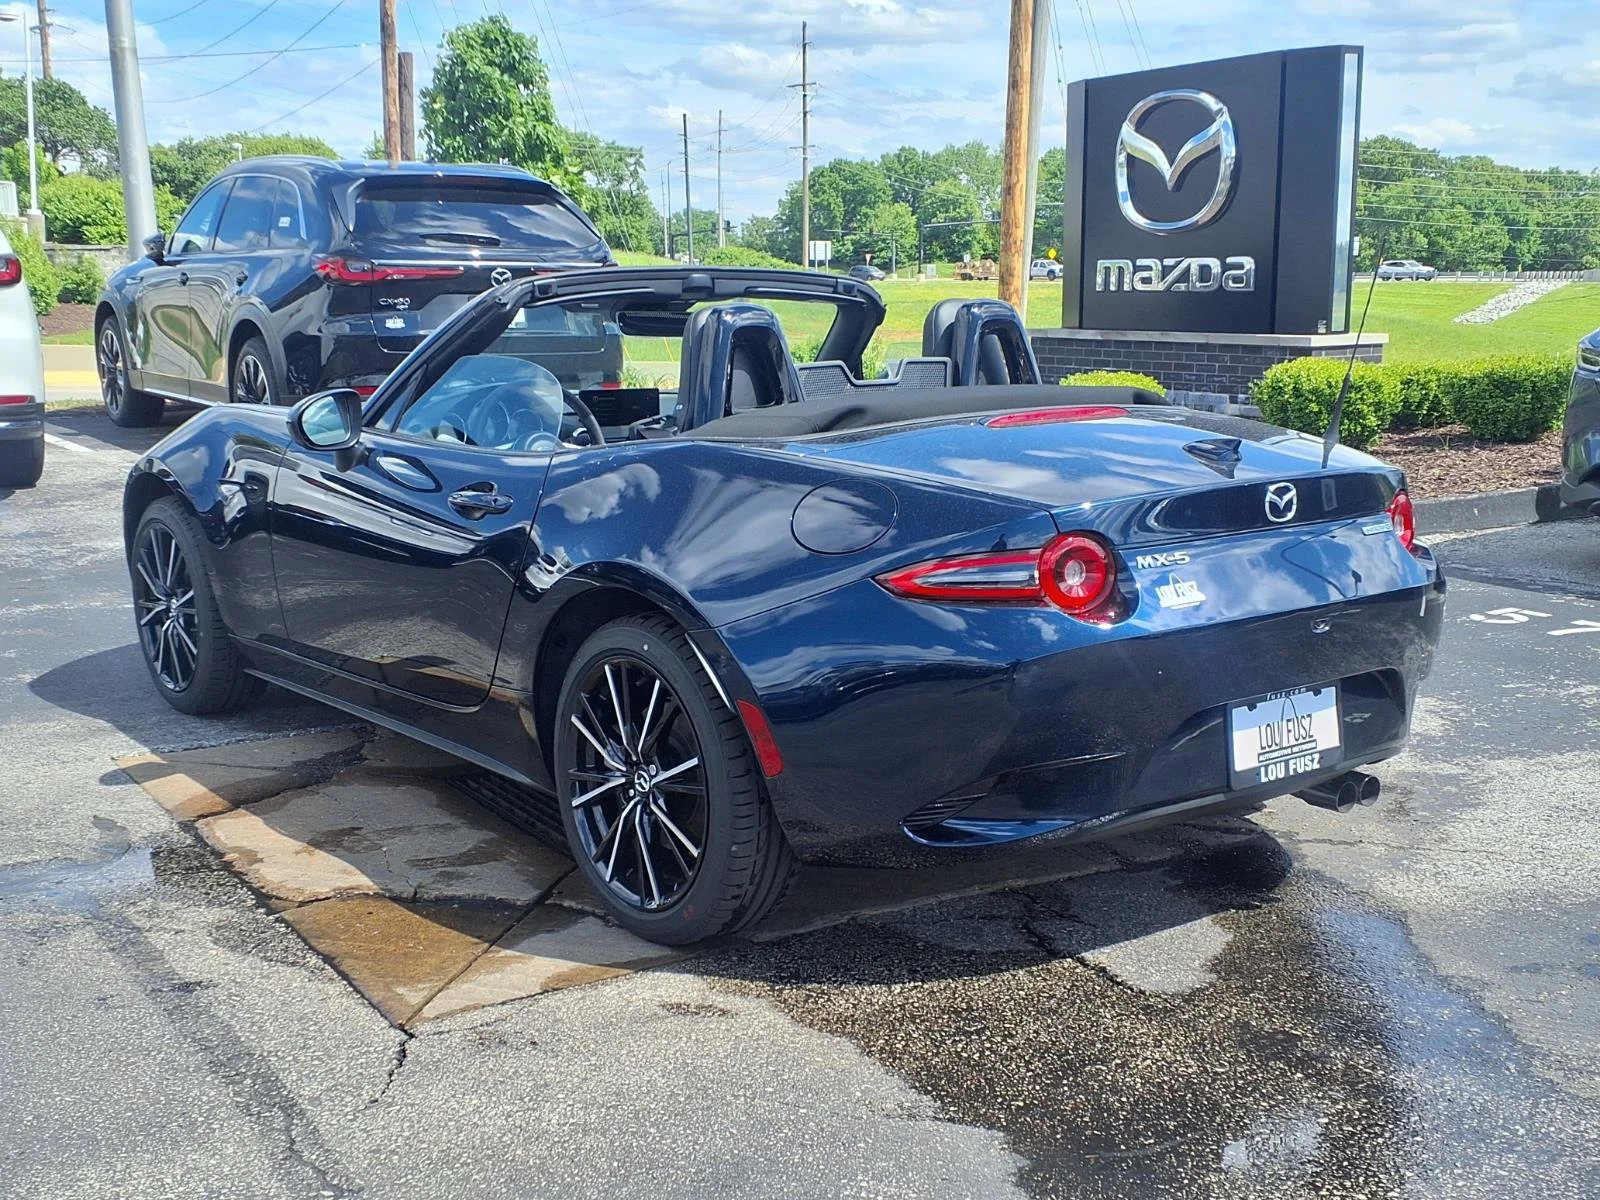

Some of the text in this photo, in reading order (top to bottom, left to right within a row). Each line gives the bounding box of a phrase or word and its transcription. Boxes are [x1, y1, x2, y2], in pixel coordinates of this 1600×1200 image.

[1136, 552, 1191, 569] MX-5
[1258, 713, 1314, 751] LOU FUSZ
[1260, 752, 1321, 783] LOU FUSZ
